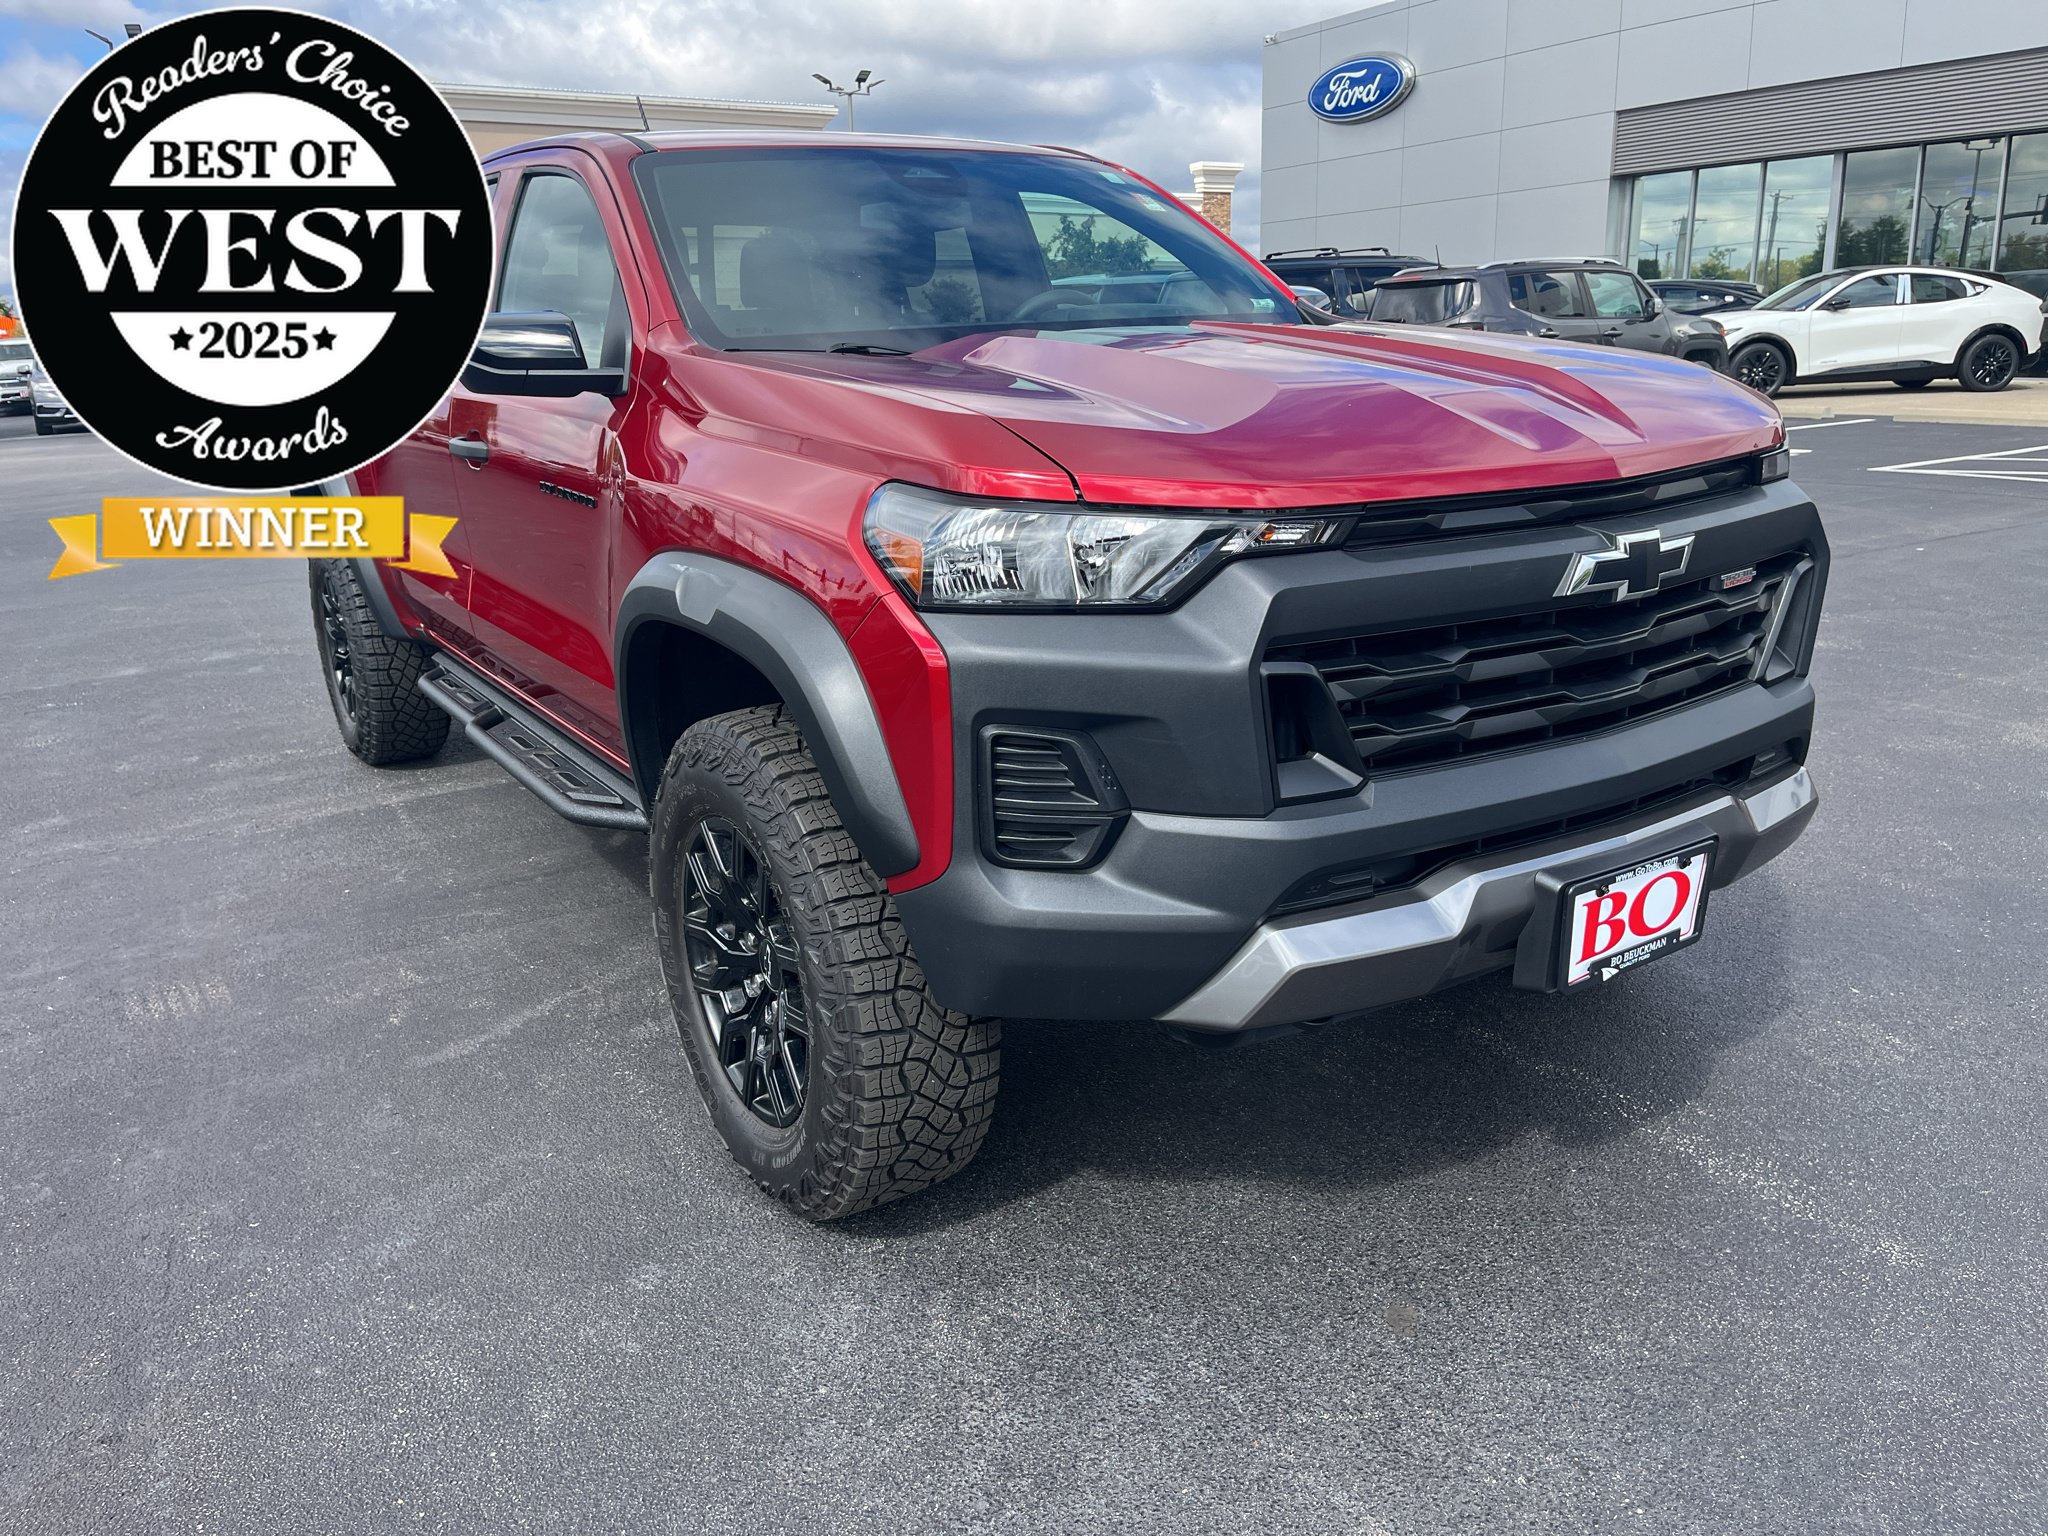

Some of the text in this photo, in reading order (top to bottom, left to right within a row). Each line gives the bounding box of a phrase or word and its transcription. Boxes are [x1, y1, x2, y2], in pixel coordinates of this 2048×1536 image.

[1323, 68, 1382, 111] Ford
[1576, 870, 1691, 966] BO
[1610, 937, 1667, 967] BO BEUCKMAN
